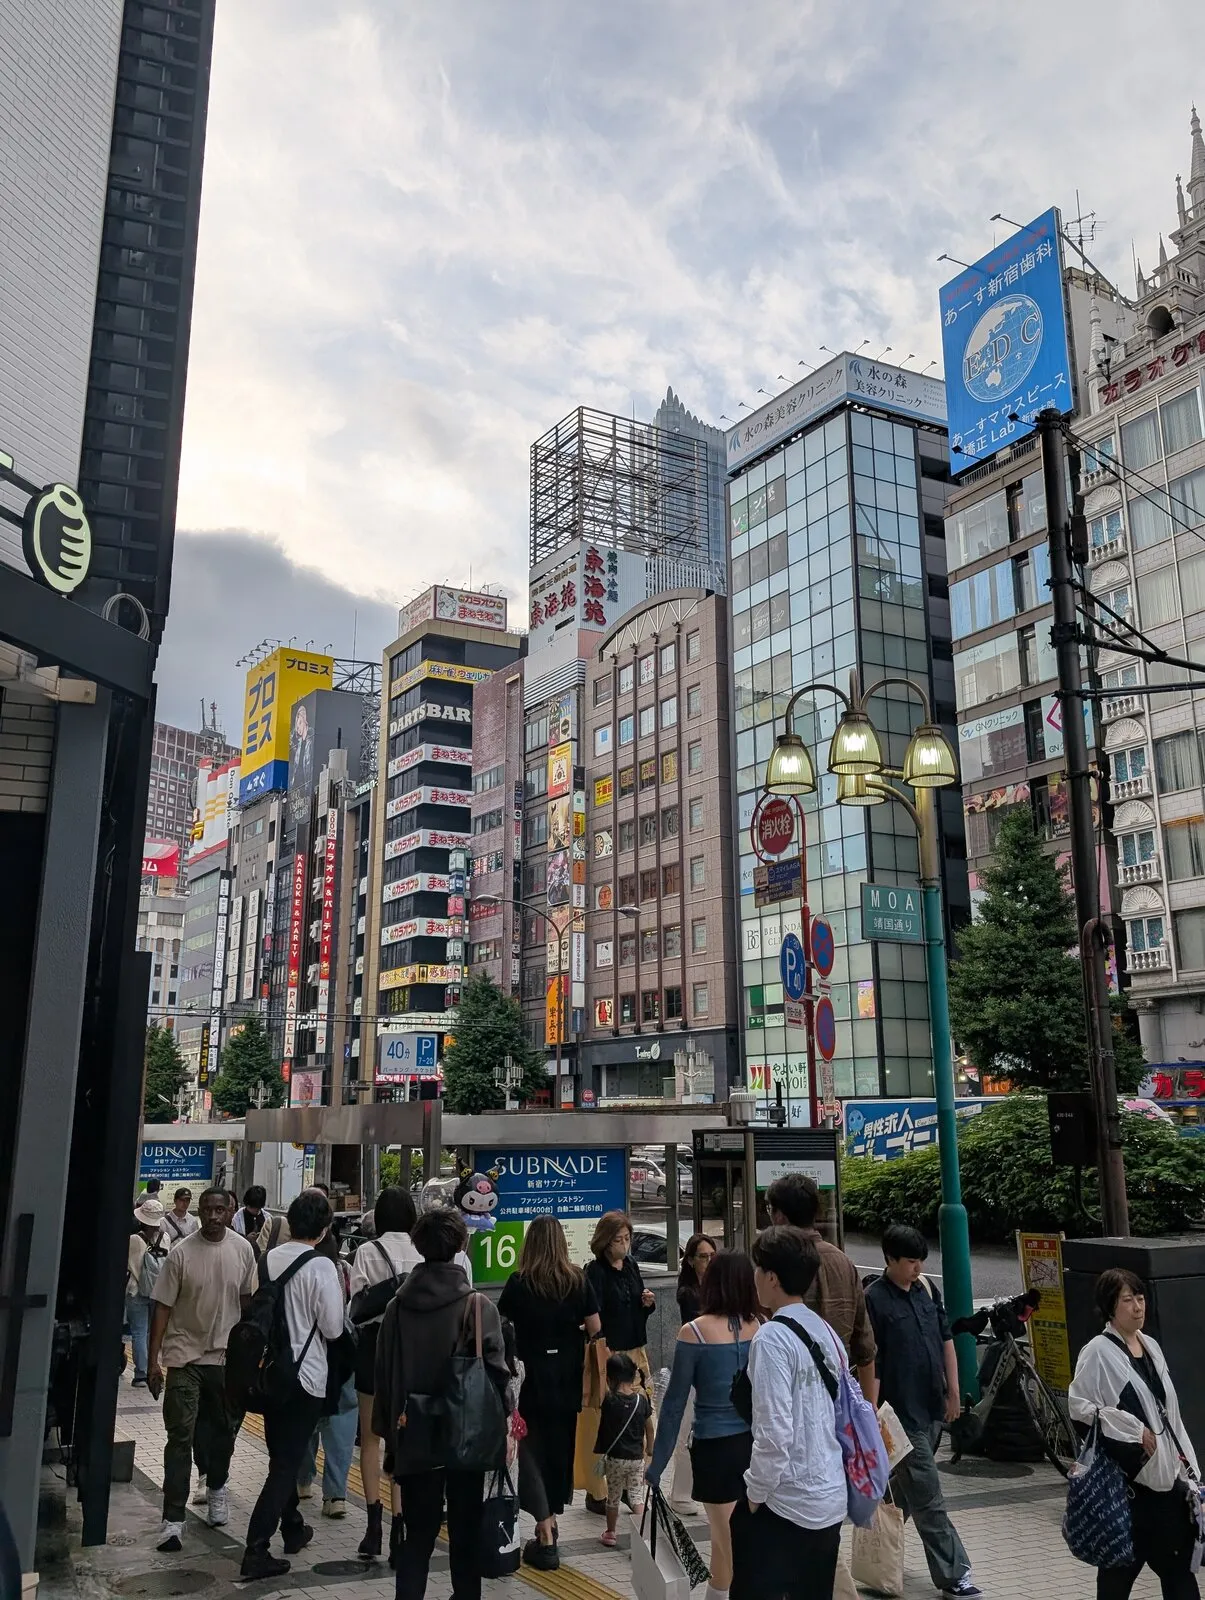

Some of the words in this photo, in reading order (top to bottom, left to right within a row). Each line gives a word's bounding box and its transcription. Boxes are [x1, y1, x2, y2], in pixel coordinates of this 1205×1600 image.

[944, 238, 1054, 327] あーす新宿歯科
[867, 365, 907, 389] 水の森
[742, 369, 843, 443] 水の森美容クリニック
[855, 379, 922, 408] 美容クリニック
[991, 421, 1016, 443] Lab
[582, 546, 607, 626] 東海苑
[530, 580, 577, 631] 東海苑
[286, 658, 330, 676] プロミス
[249, 671, 276, 719] プロ
[389, 703, 426, 737] DARTS
[426, 702, 471, 723] BAR
[975, 711, 1018, 731] GNクリニック
[246, 711, 273, 756] ミス
[761, 814, 792, 840] 消火栓
[294, 854, 304, 906] KARAOKE
[873, 917, 912, 932] 靖国通り
[292, 921, 300, 957] PARTY
[786, 948, 796, 988] P
[286, 991, 296, 1055] PASELA
[387, 1041, 410, 1059] 40分
[421, 1039, 432, 1055] P
[773, 1062, 806, 1076] やよい軒
[773, 1077, 803, 1089] YAYOI
[864, 1108, 914, 1139] 男性求人
[141, 1146, 207, 1159] UBNADE
[494, 1155, 608, 1178] SUBNADE
[527, 1179, 577, 1189] 新宿サブナード
[557, 1195, 584, 1203] レストラン
[480, 1234, 516, 1269] 16
